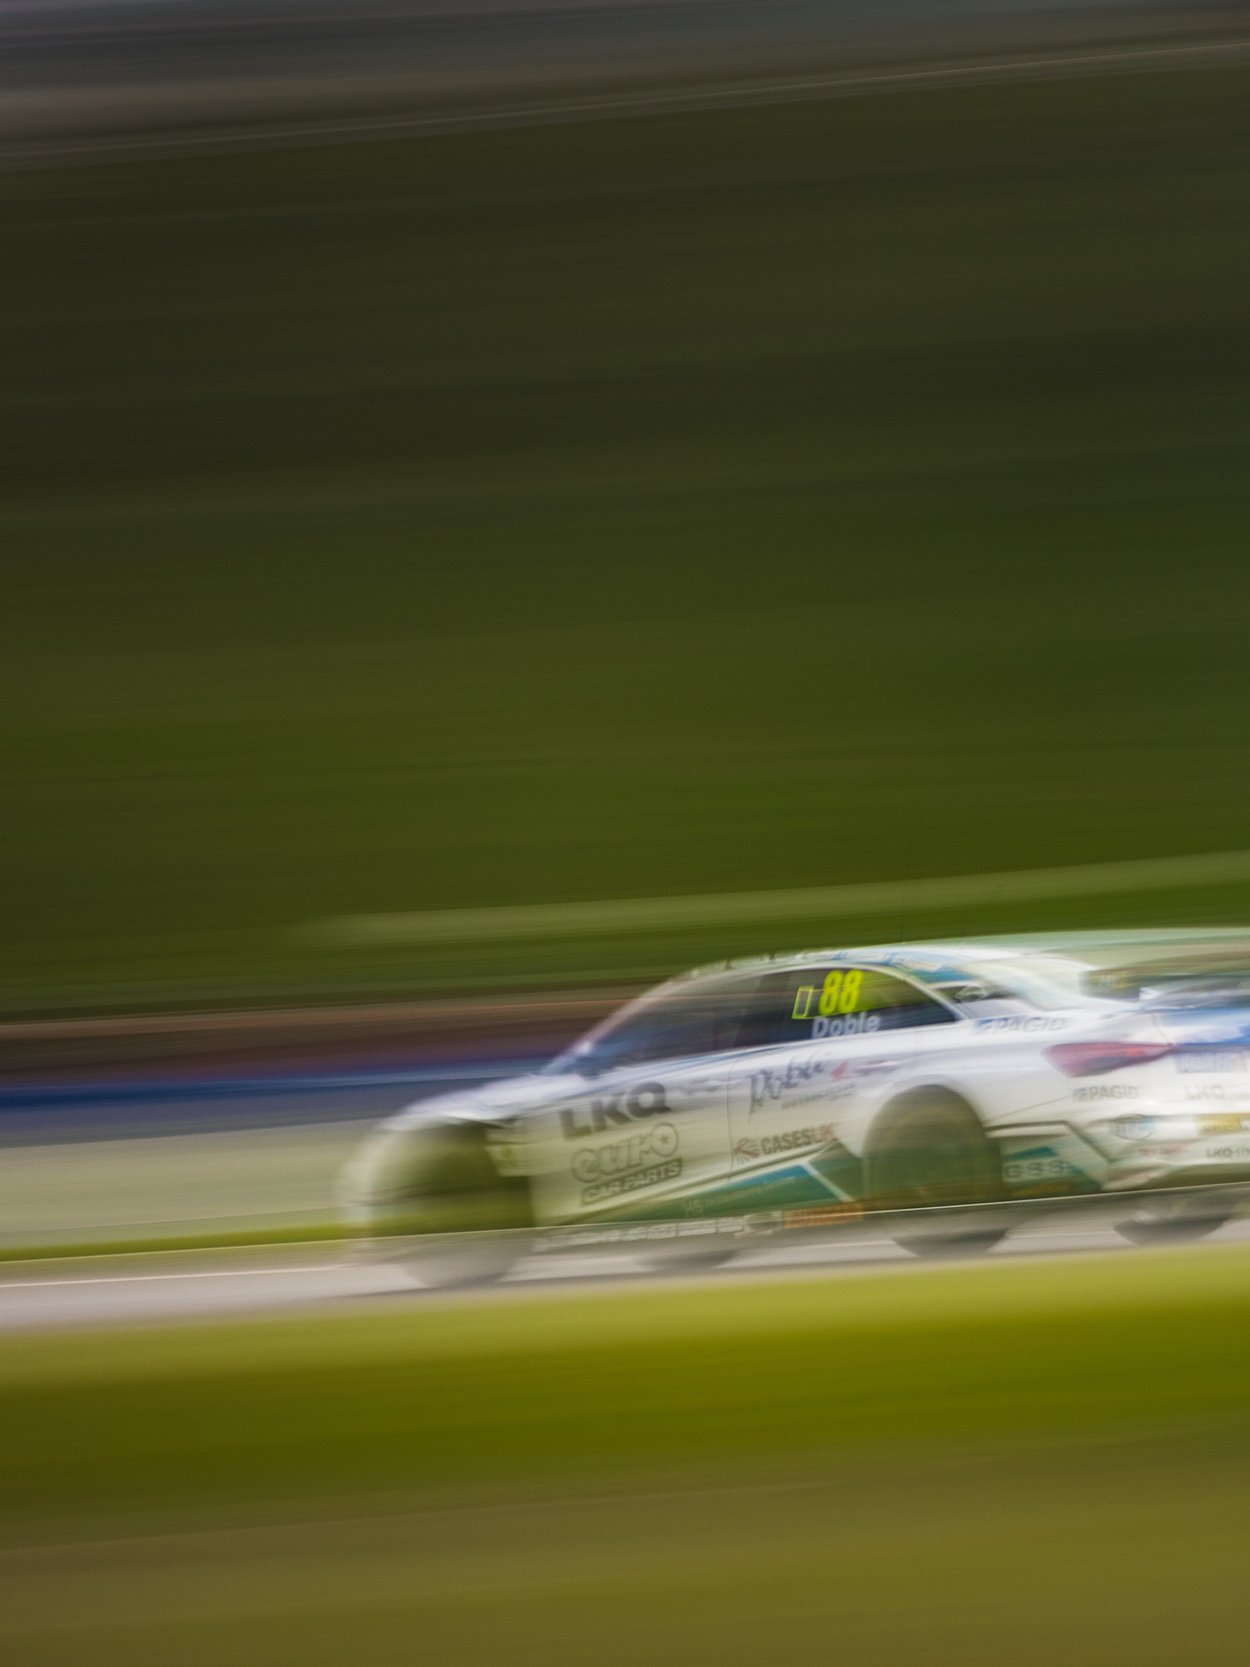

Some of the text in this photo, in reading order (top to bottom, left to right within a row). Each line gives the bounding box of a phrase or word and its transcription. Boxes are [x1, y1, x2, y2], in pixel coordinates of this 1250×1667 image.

[818, 969, 865, 1016] 88
[811, 1011, 881, 1039] Doble
[1088, 1085, 1139, 1100] PAGID
[559, 1082, 672, 1142] LKQ
[624, 1160, 681, 1190] PARTS
